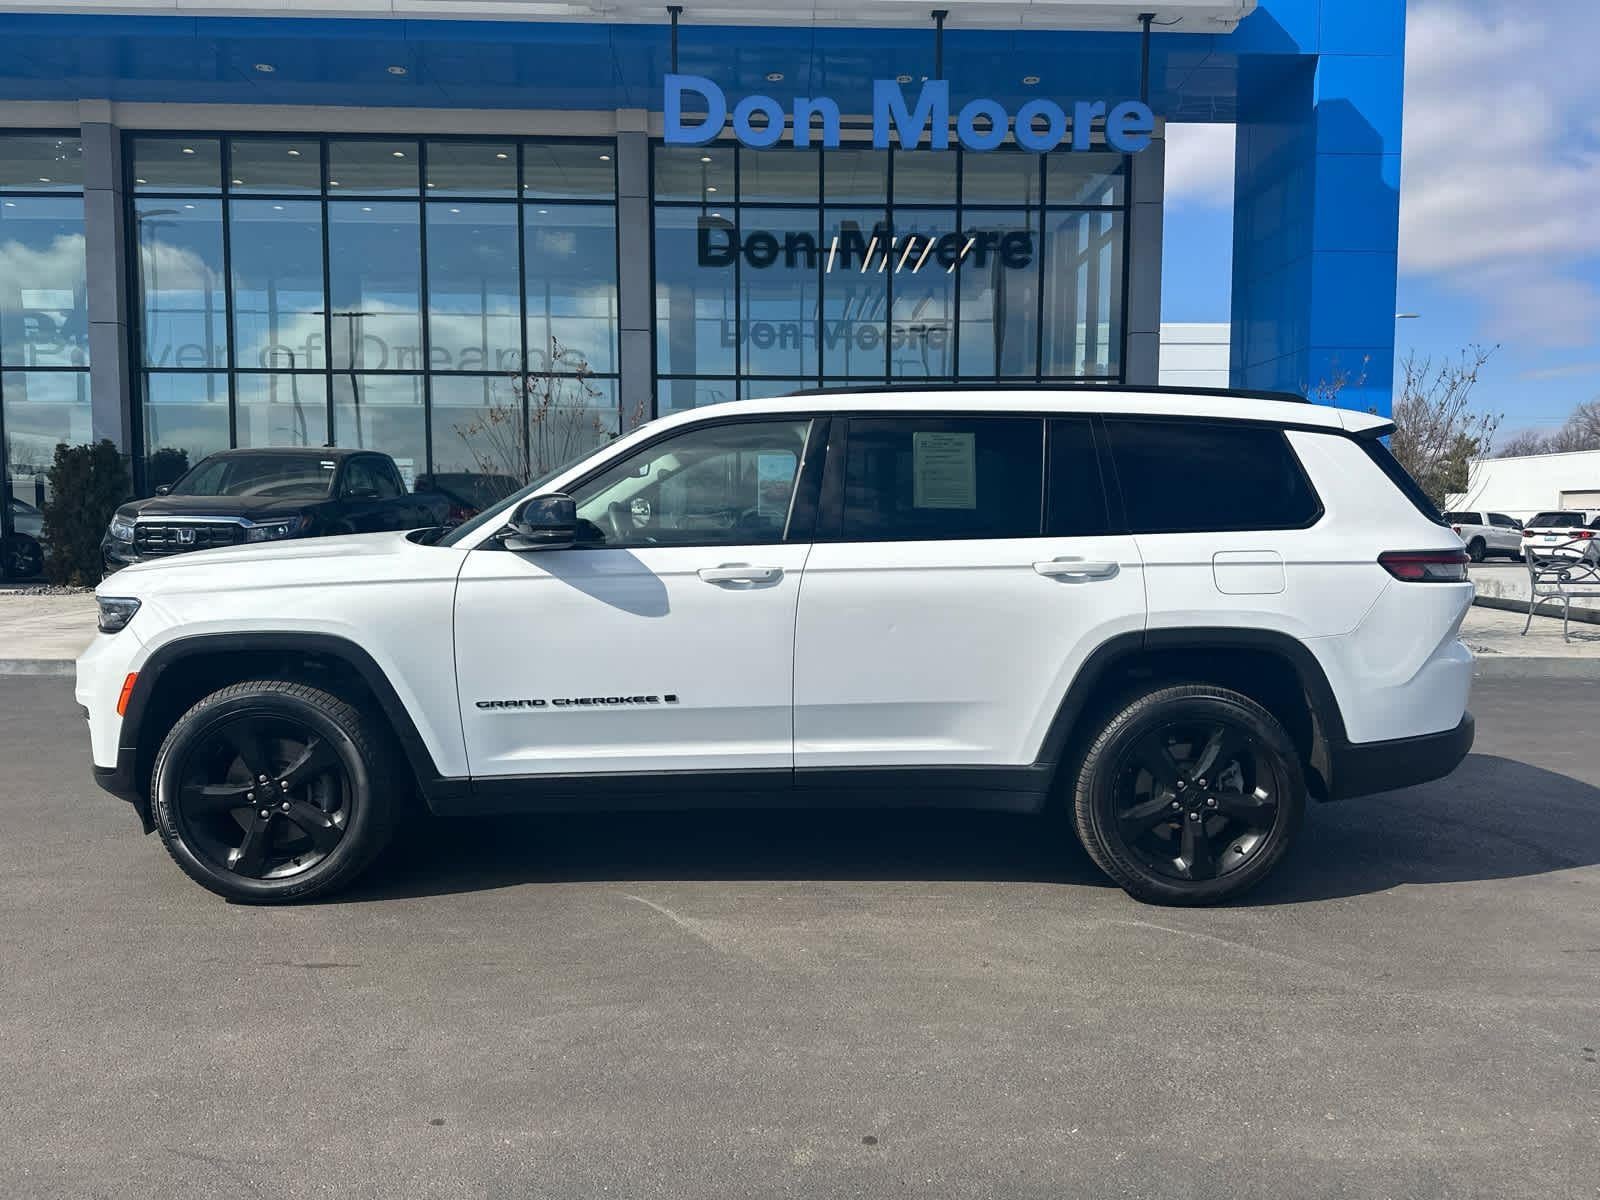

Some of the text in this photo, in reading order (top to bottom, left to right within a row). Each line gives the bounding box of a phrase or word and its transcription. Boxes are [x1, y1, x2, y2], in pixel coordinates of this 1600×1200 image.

[663, 73, 1156, 153] Don Moore
[697, 215, 1034, 271] Don Moore
[475, 699, 547, 709] GRAND
[551, 695, 659, 706] CHEROKEE
